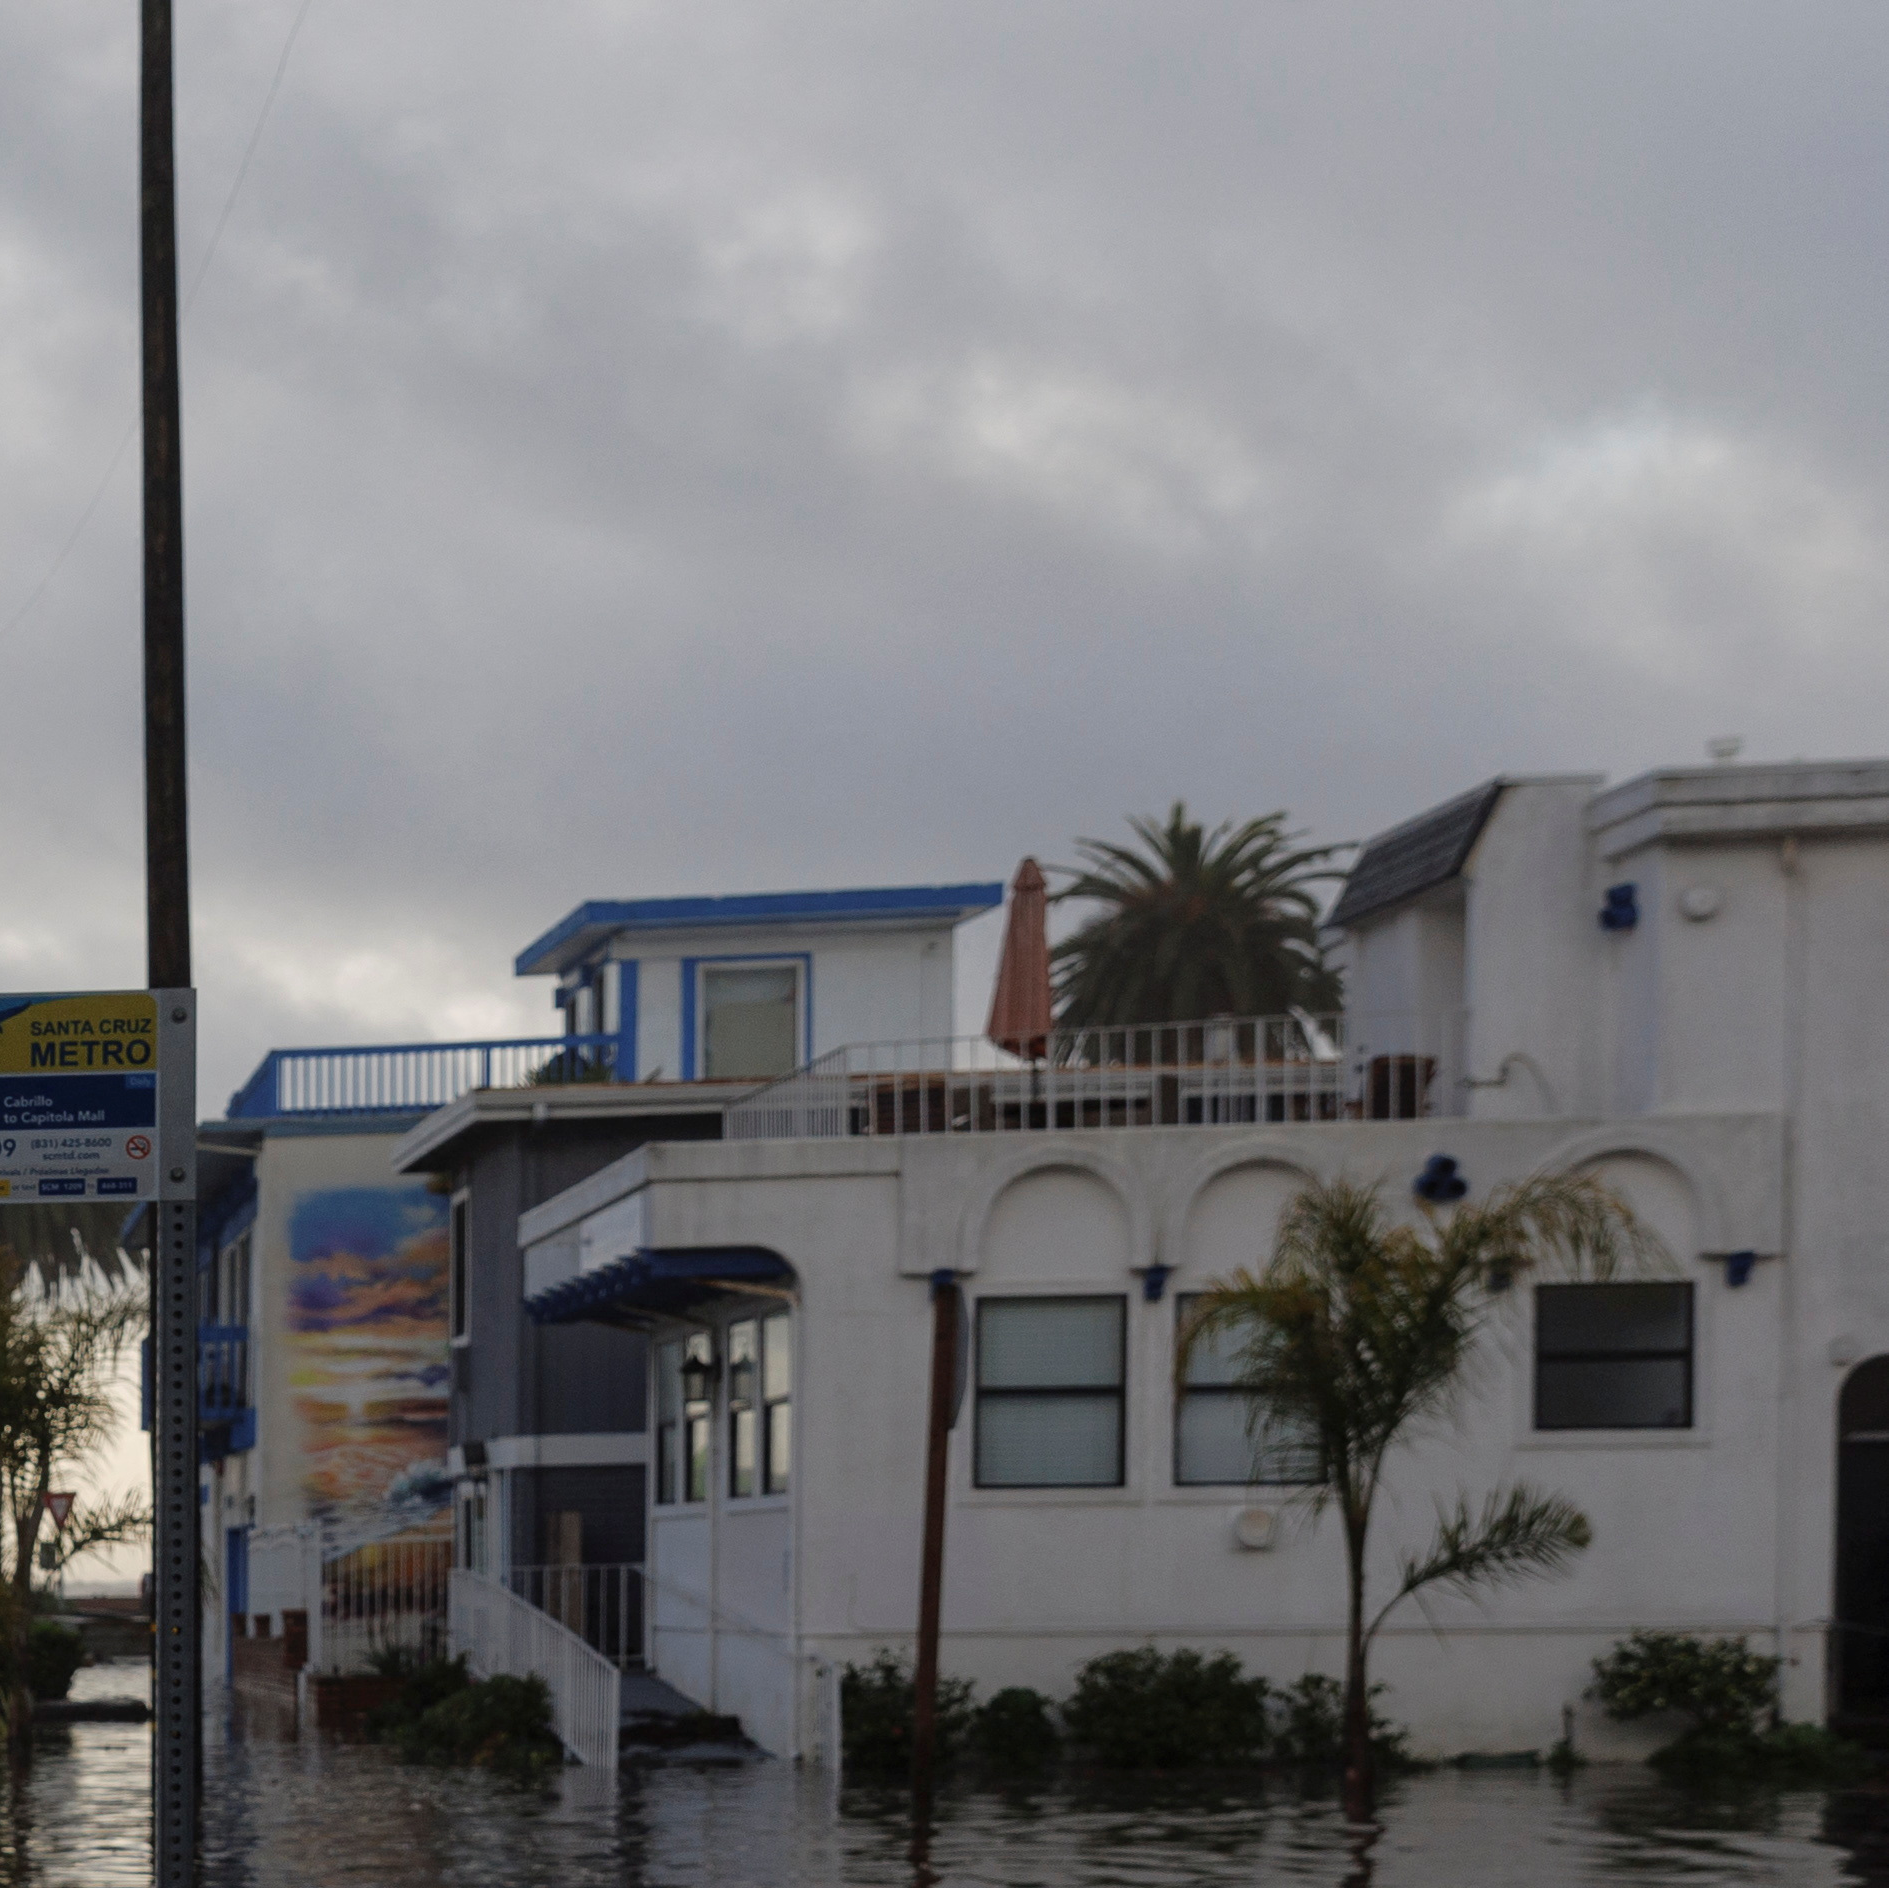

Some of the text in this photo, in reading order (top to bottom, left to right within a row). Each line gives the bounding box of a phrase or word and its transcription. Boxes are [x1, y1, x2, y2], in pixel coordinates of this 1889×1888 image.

[30, 1018, 152, 1036] SANTA CRUZ
[30, 1038, 152, 1067] METRO
[3, 1096, 53, 1108] Cabrillo
[3, 1110, 106, 1126] to Capitola Mall
[30, 1137, 112, 1150] (831) 425-8600
[43, 1150, 100, 1160] scmtd.com
